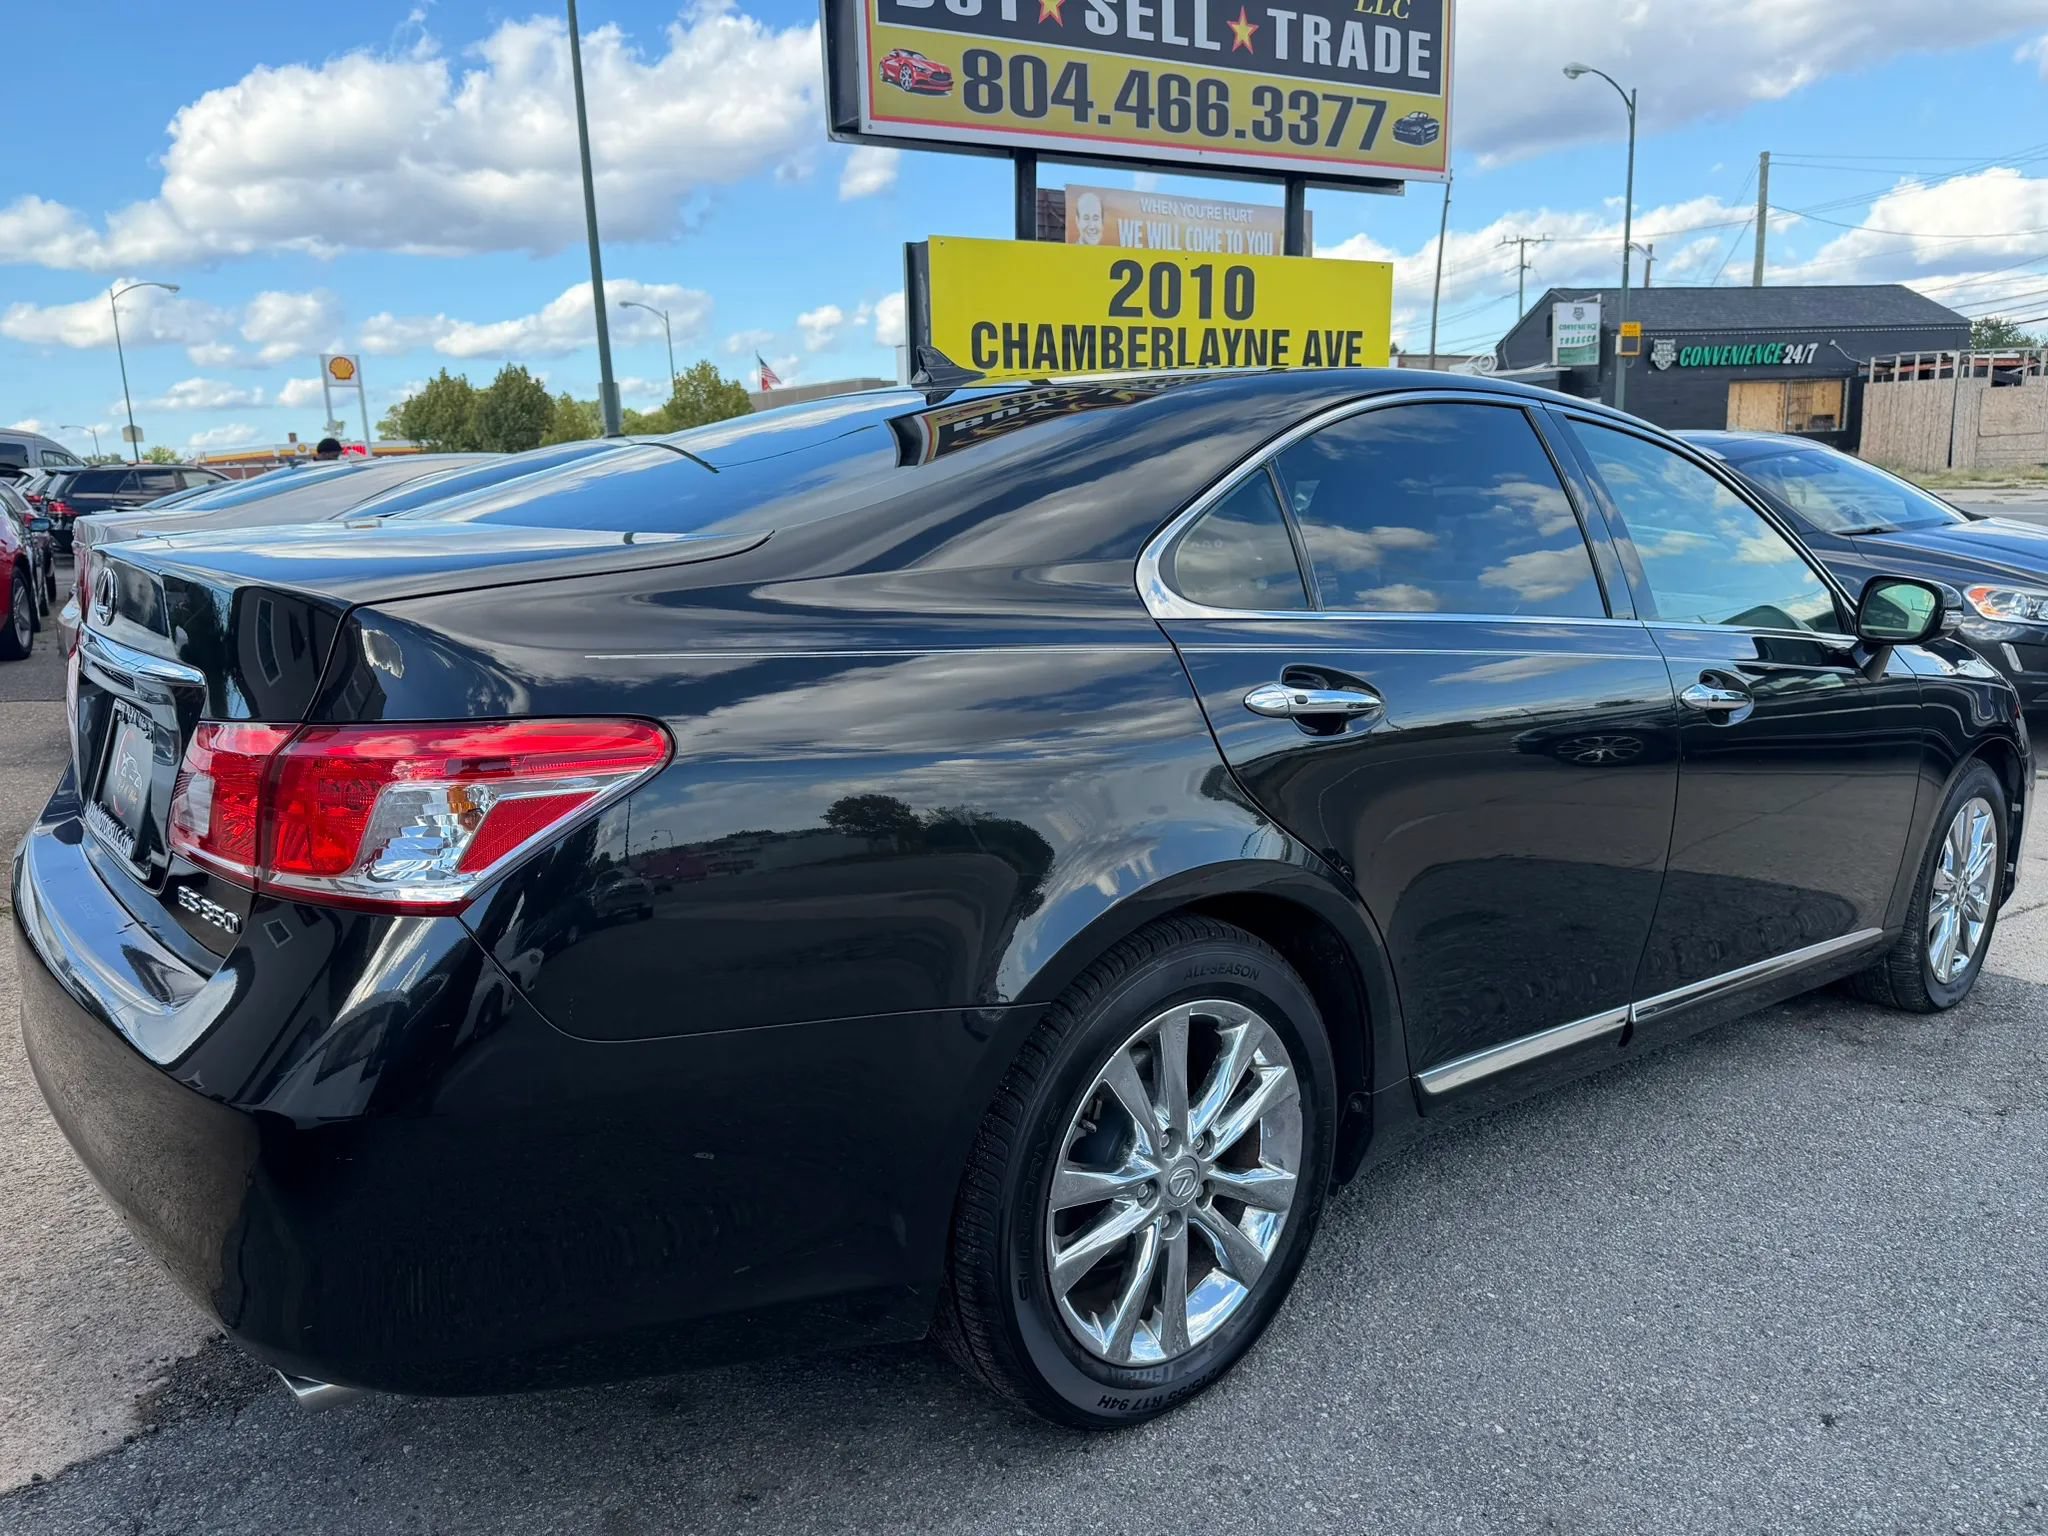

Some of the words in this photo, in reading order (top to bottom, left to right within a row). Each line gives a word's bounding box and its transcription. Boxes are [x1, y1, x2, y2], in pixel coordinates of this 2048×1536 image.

[1084, 0, 1221, 51] SELL
[1266, 8, 1431, 80] TRADE
[962, 48, 1387, 151] 804.466.3377
[1140, 197, 1178, 217] WHEN
[1179, 201, 1221, 219] YOU'RE
[1222, 207, 1255, 224] HURT
[1118, 218, 1143, 248] WE
[1146, 219, 1182, 250] WILL
[1184, 223, 1222, 253] COME
[1225, 228, 1244, 255] TO
[1246, 229, 1273, 256] YOU
[1108, 258, 1256, 321] 2010
[970, 320, 1290, 371] CHAMBERLAYNE
[1302, 329, 1364, 367] AVE
[1560, 335, 1597, 345] TOBACCO
[1184, 962, 1260, 981] ALL-SEASON
